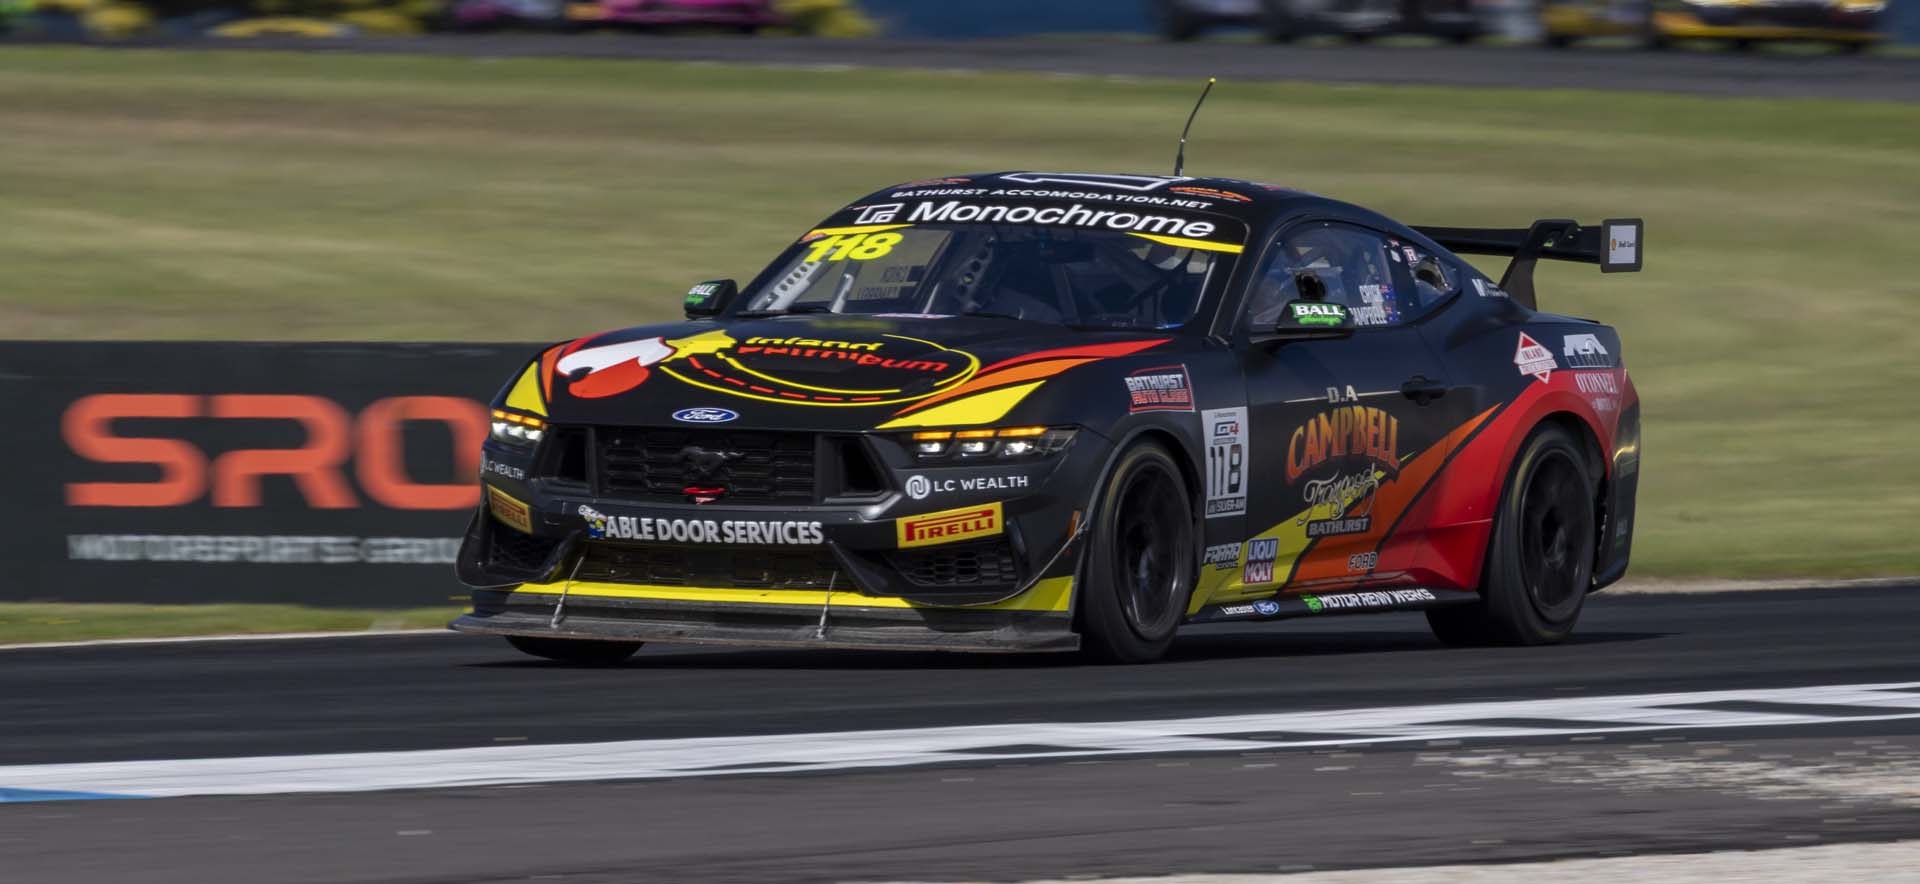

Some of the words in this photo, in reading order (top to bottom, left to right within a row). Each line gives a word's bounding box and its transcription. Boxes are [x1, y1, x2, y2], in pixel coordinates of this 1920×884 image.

[891, 188, 989, 198] BATHURST
[990, 189, 1213, 209] ACCOMODATION.NET
[907, 200, 1216, 237] Monochrome
[803, 232, 904, 262] 118
[1296, 305, 1345, 316] BALL
[1124, 373, 1183, 391] BATHURST
[1326, 384, 1358, 403] D.A
[678, 408, 732, 421] Ford
[61, 393, 489, 510] SRO
[1286, 405, 1400, 481] CAMPBELL
[495, 463, 525, 480] WEALTH
[1210, 444, 1242, 496] 118
[934, 480, 956, 492] LC
[960, 475, 1029, 490] WEALTH
[606, 516, 655, 540] ABLE
[656, 518, 722, 543] DOOR
[722, 520, 824, 545] SERVICES
[904, 509, 995, 542] PIRELLI
[1308, 518, 1369, 535] BATHURST
[67, 534, 360, 563] MOTORSPORTS
[1248, 540, 1277, 560] LIQUI
[1245, 562, 1273, 582] MOLY
[1318, 593, 1361, 609] MOTOR
[1358, 591, 1393, 606] RENN
[1390, 588, 1436, 603] WERKS
